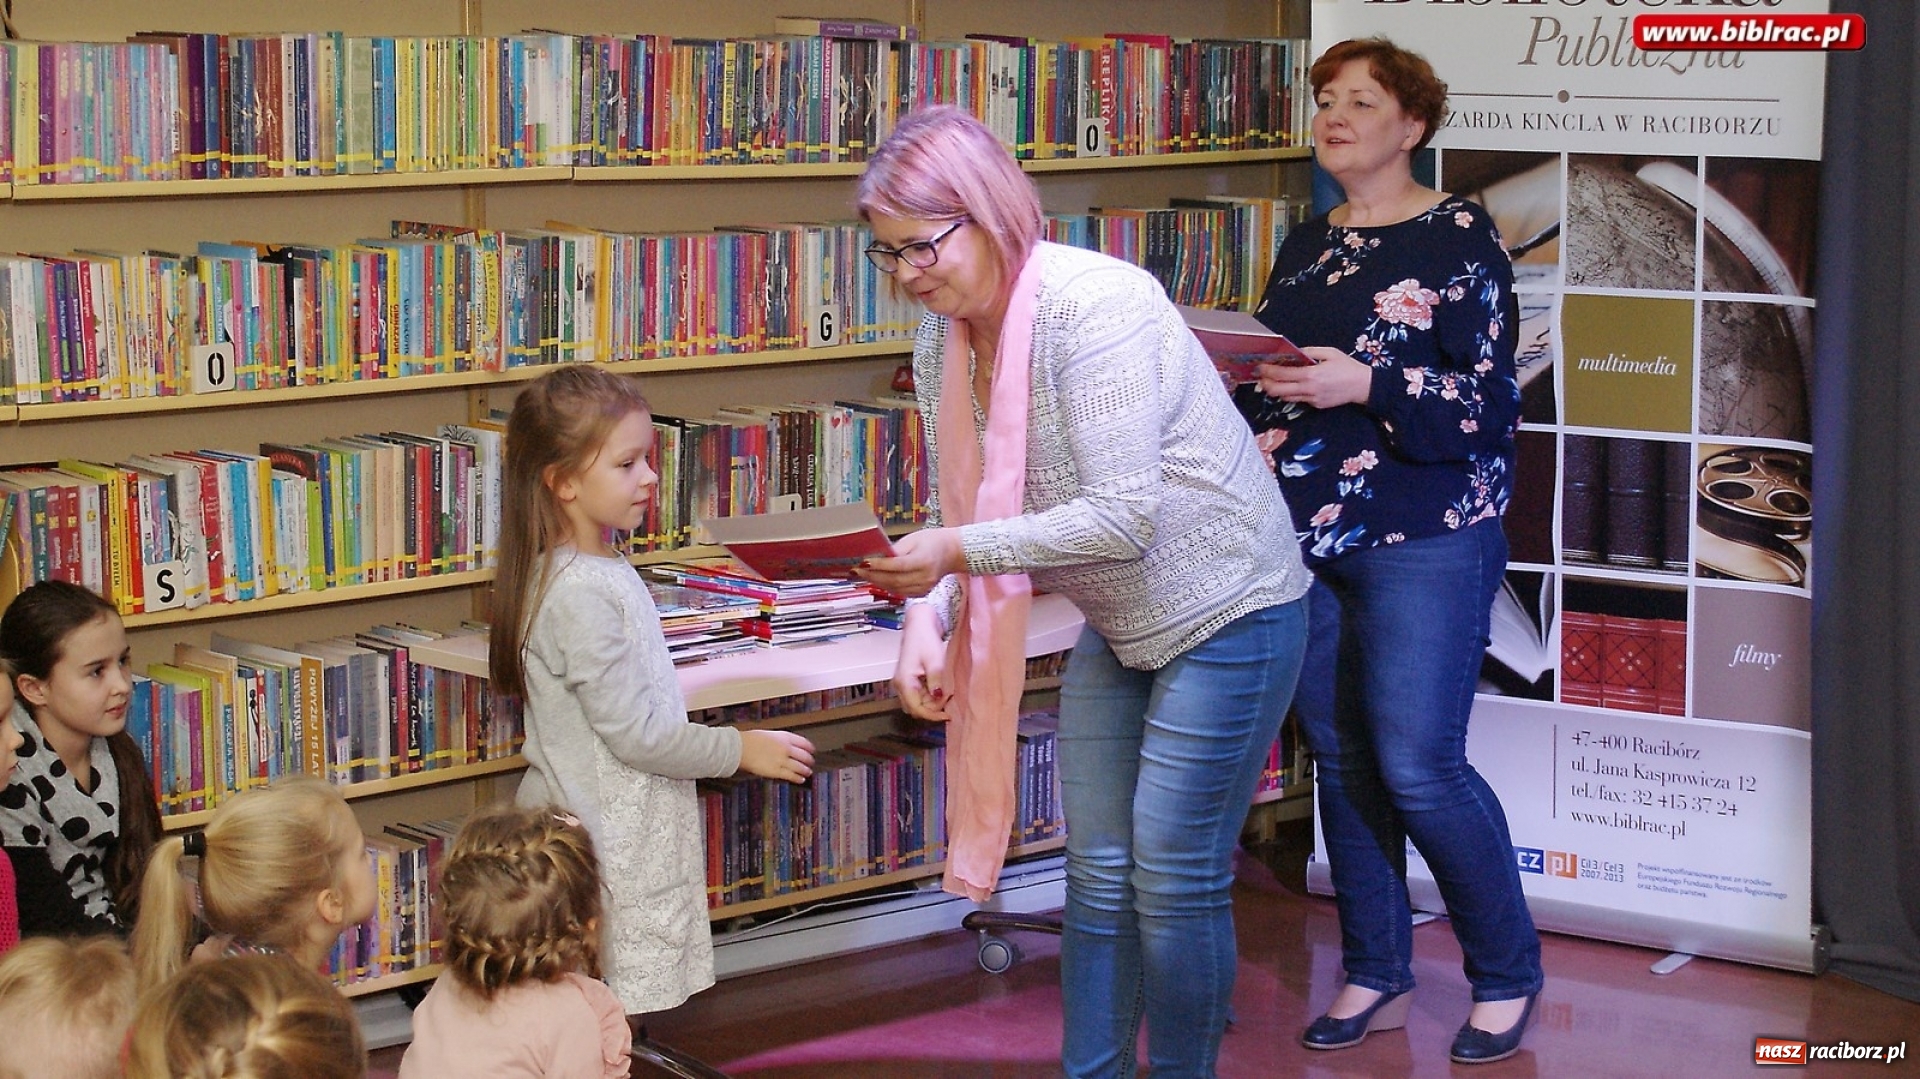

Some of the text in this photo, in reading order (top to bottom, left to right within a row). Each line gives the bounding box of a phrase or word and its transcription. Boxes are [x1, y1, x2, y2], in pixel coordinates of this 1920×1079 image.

[812, 39, 820, 99] SARAH DESSEN
[1101, 54, 1110, 126] REPLIKA
[582, 94, 593, 138] KORONA
[1522, 112, 1605, 132] KINCLA
[1614, 114, 1634, 132] W
[1642, 115, 1782, 136] RACIBORZU
[820, 311, 833, 342] G
[1577, 353, 1677, 376] multimedia
[156, 569, 175, 603] S
[1728, 643, 1782, 671] filmy
[308, 667, 320, 778] POWYŻEJ 15 LAT
[1571, 730, 1700, 760] 47-400 Racibórz
[1571, 757, 1757, 792] ul. Jana Kasprowicza 12
[1632, 789, 1652, 807] 32
[1657, 793, 1687, 811] 415
[1692, 797, 1712, 814] 37
[1716, 799, 1738, 817] 24
[1571, 811, 1686, 840] www.biblrac.pl
[1551, 853, 1572, 877] pl
